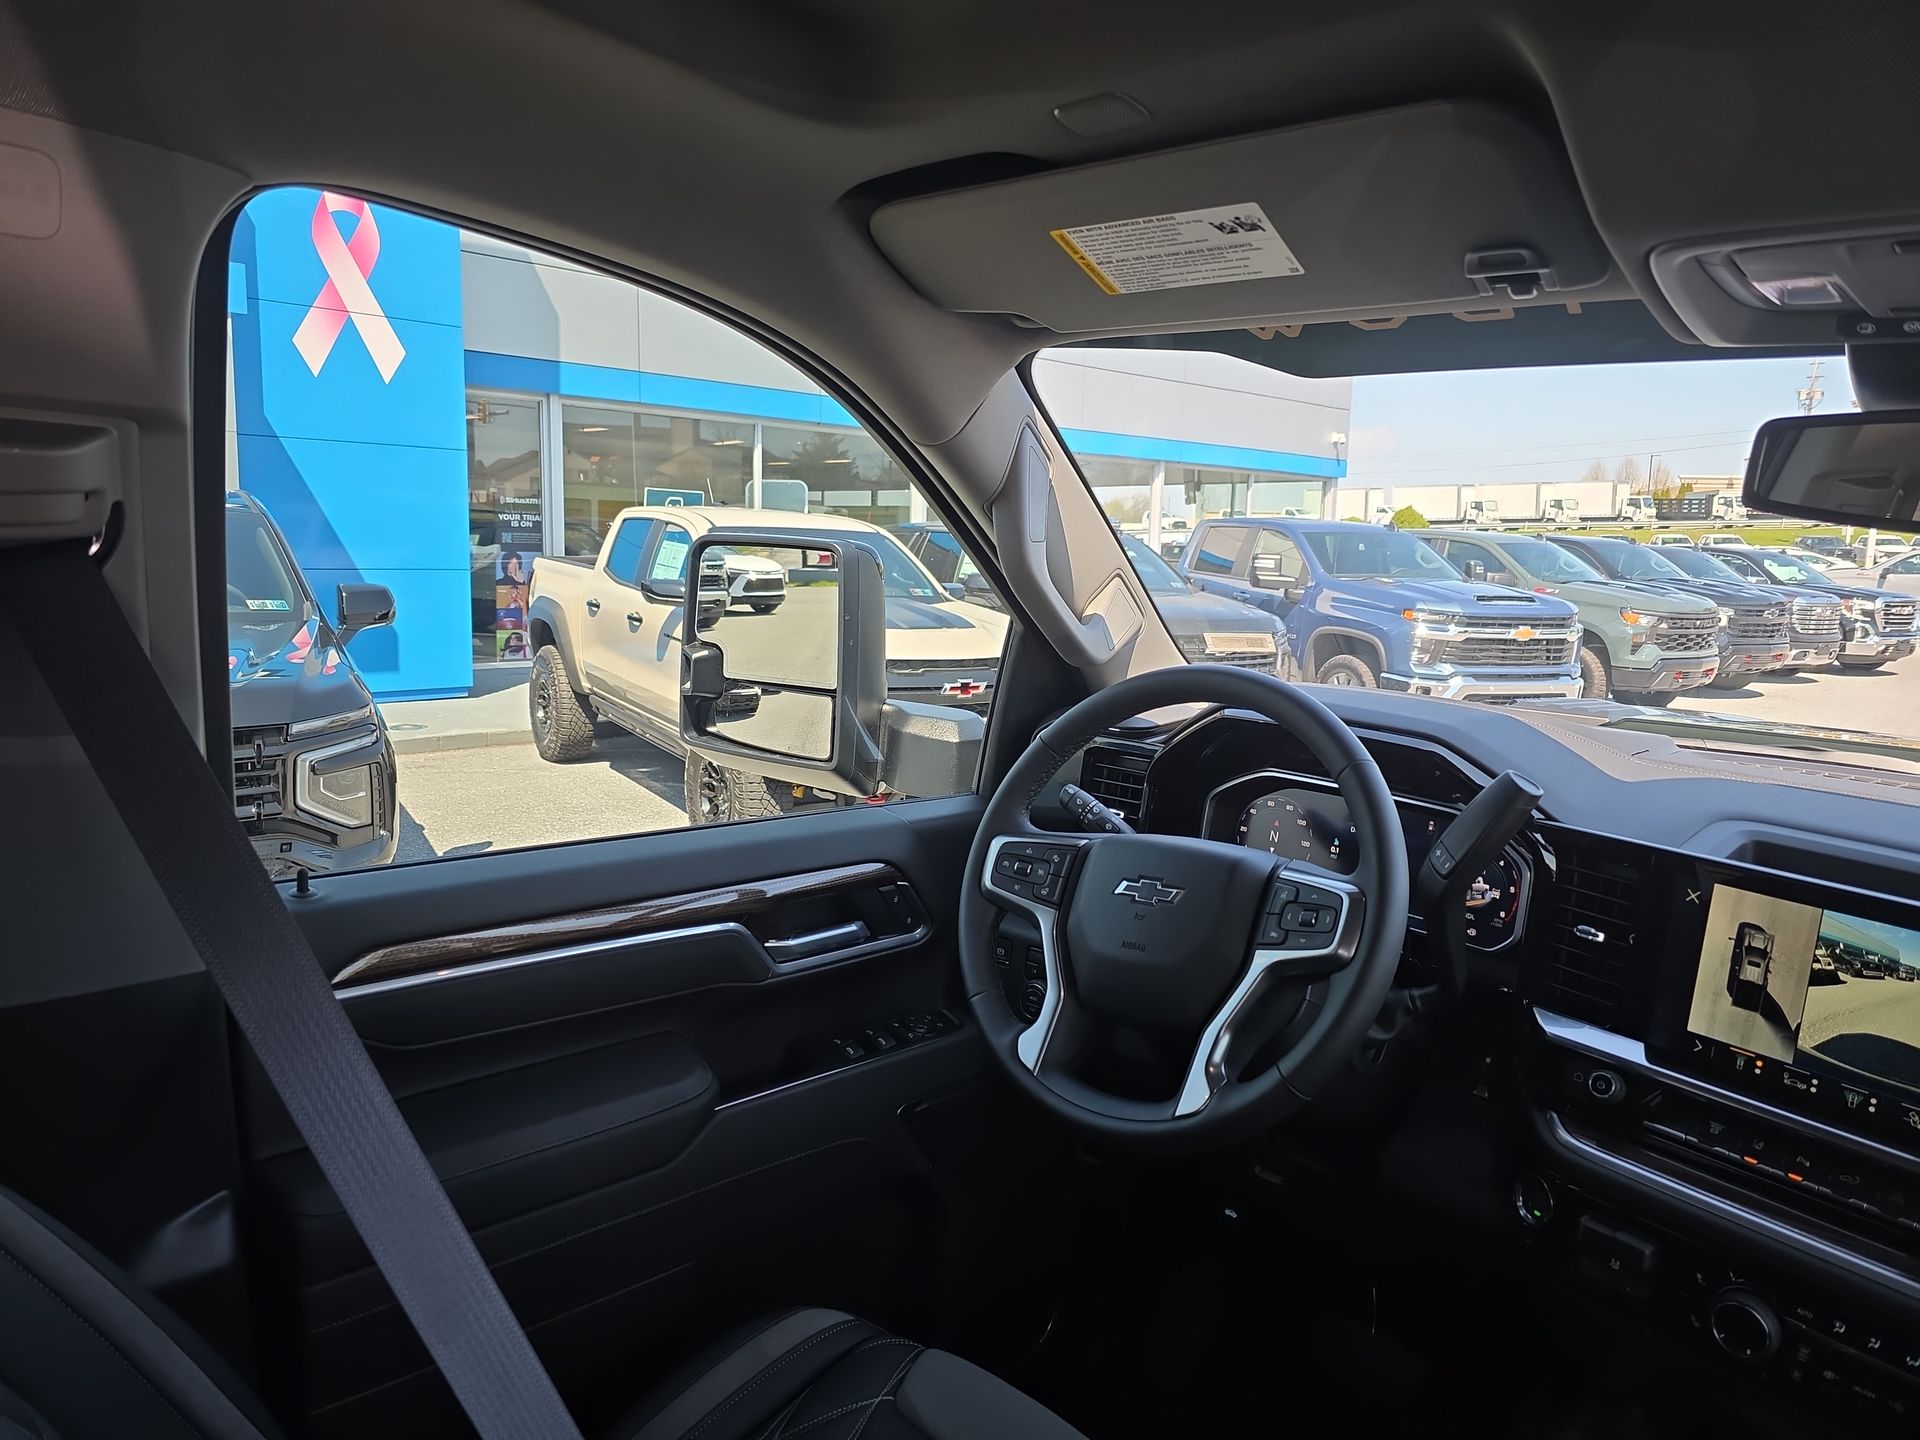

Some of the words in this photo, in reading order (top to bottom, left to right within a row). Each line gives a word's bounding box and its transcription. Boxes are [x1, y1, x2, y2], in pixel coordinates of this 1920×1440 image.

[1104, 221, 1141, 230] ADVANCED
[1269, 830, 1279, 843] N
[1301, 840, 1311, 848] 120
[1796, 1307, 1814, 1320] AUTO
